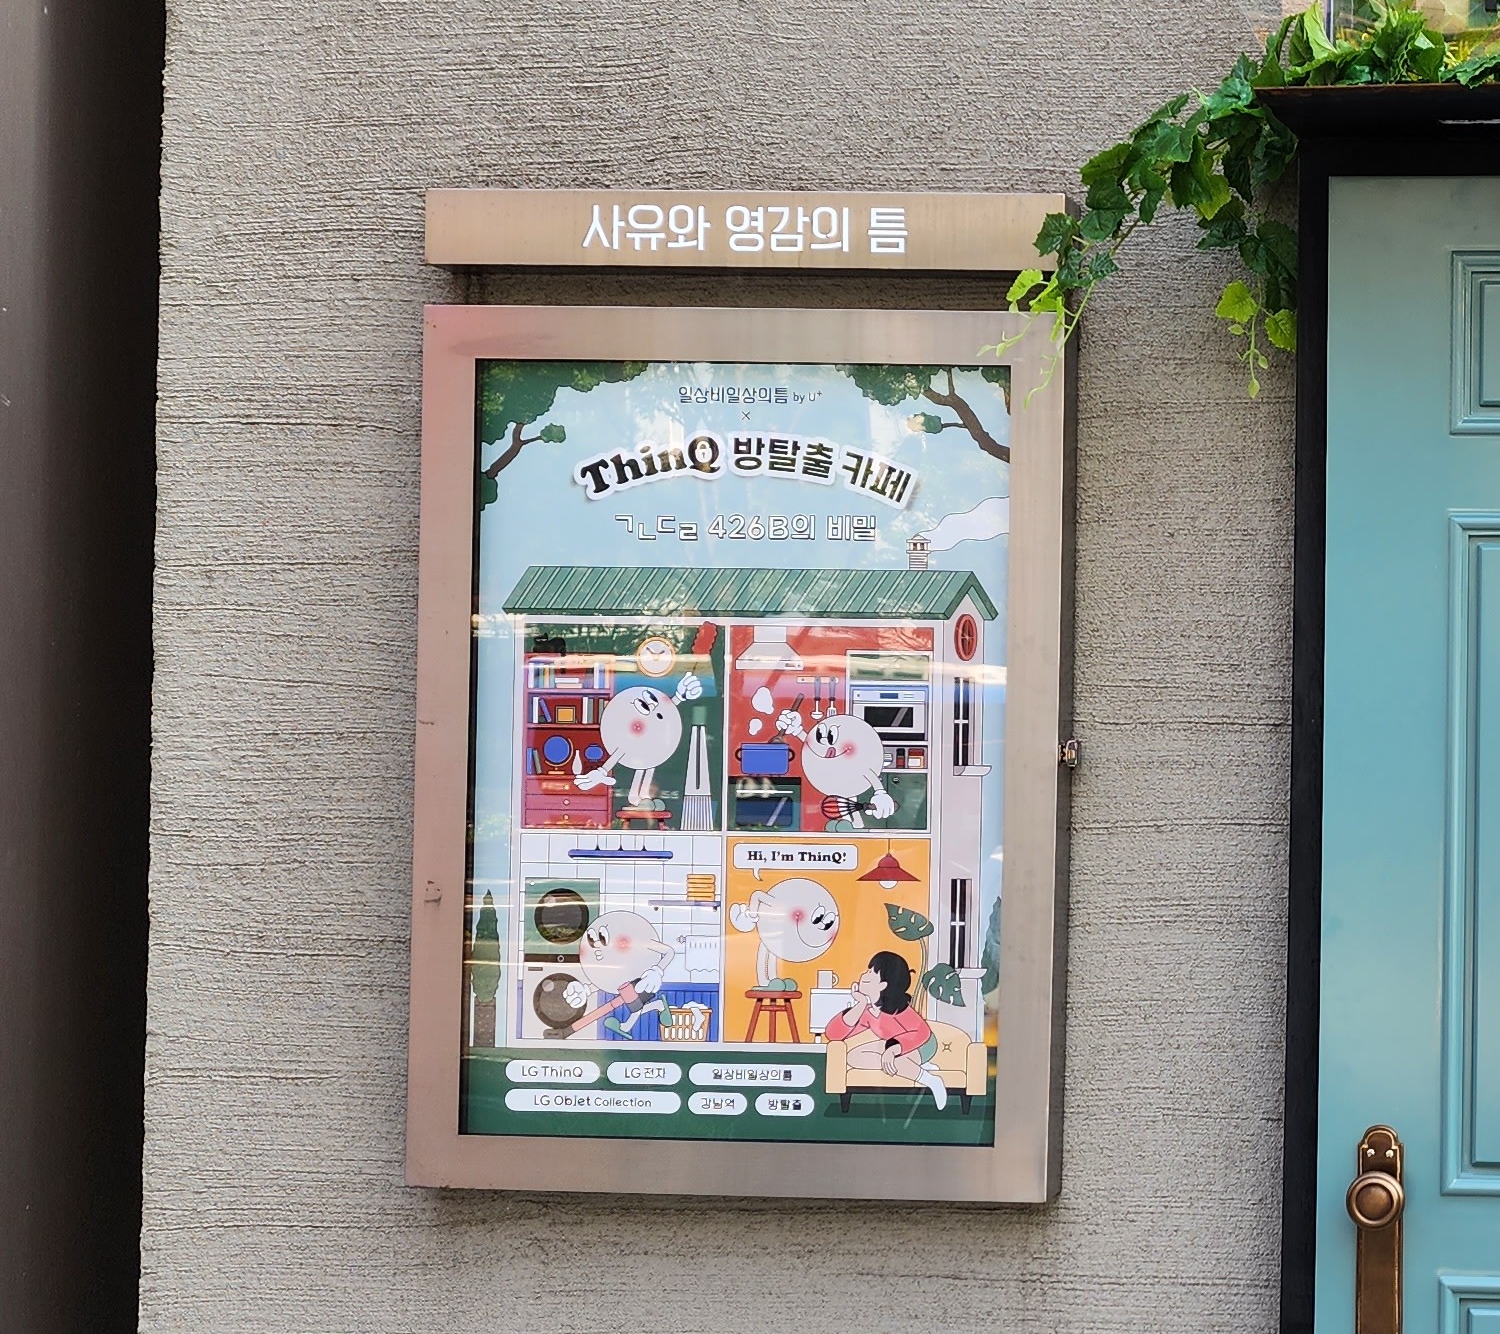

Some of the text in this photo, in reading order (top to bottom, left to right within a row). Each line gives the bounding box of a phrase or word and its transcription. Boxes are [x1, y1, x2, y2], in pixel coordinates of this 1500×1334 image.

[582, 204, 908, 253] 사유와 영감의 틈
[678, 386, 788, 404] 일상비일상의틈
[793, 391, 806, 405] by
[580, 434, 914, 504] ThinQ 방탈출 카페
[707, 514, 816, 541] 426B의
[826, 514, 877, 542] 비밀
[747, 850, 767, 863] Hi,
[798, 851, 847, 864] ThinQ!
[521, 1065, 583, 1078] LG ThinQ
[624, 1067, 666, 1079] LG 전자
[534, 1094, 652, 1108] LG Objet Collection
[701, 1097, 735, 1110] 강남역
